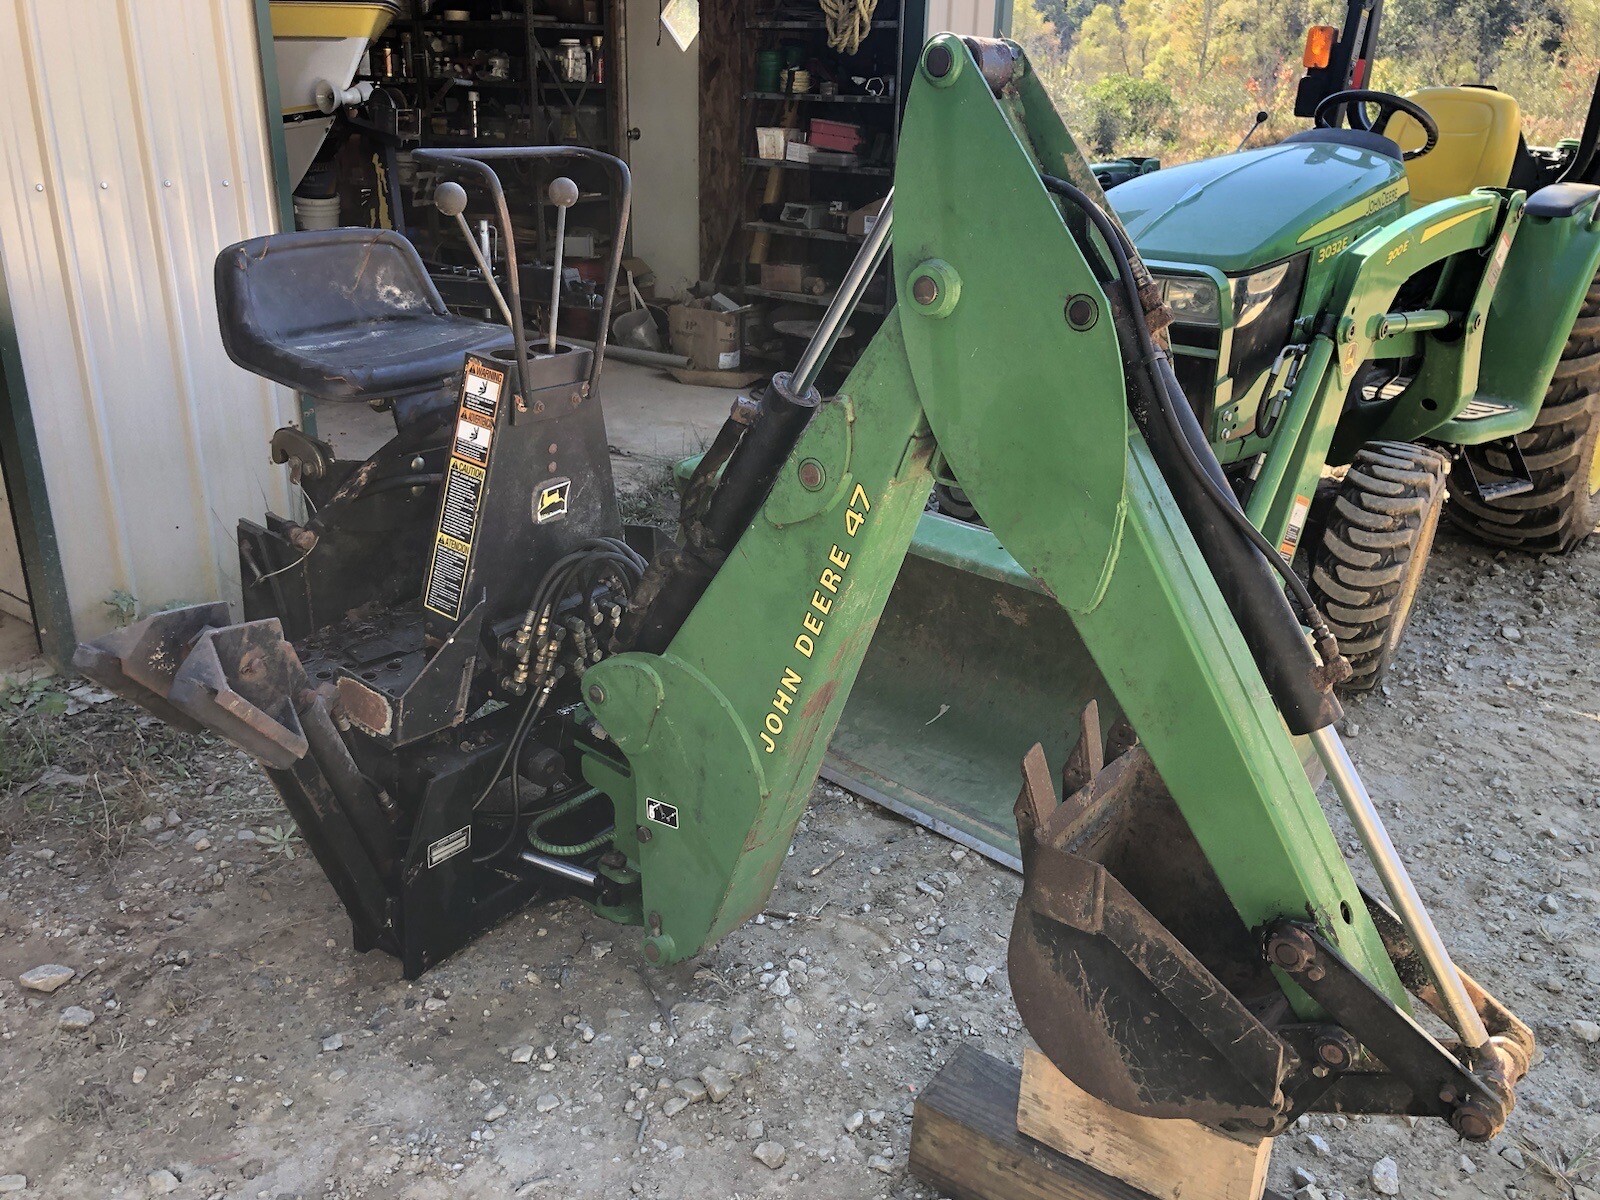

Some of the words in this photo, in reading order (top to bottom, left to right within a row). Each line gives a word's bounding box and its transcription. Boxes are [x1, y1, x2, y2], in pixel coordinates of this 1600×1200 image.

[1365, 197, 1381, 216] JOHN
[1380, 187, 1398, 208] DEERE
[1317, 235, 1349, 263] 3032E
[1386, 240, 1410, 266] 300E
[476, 365, 503, 383] WARNING
[459, 462, 485, 480] CAUTION
[758, 666, 803, 754] JOHN
[793, 543, 852, 659] DEERE
[844, 482, 872, 538] 47
